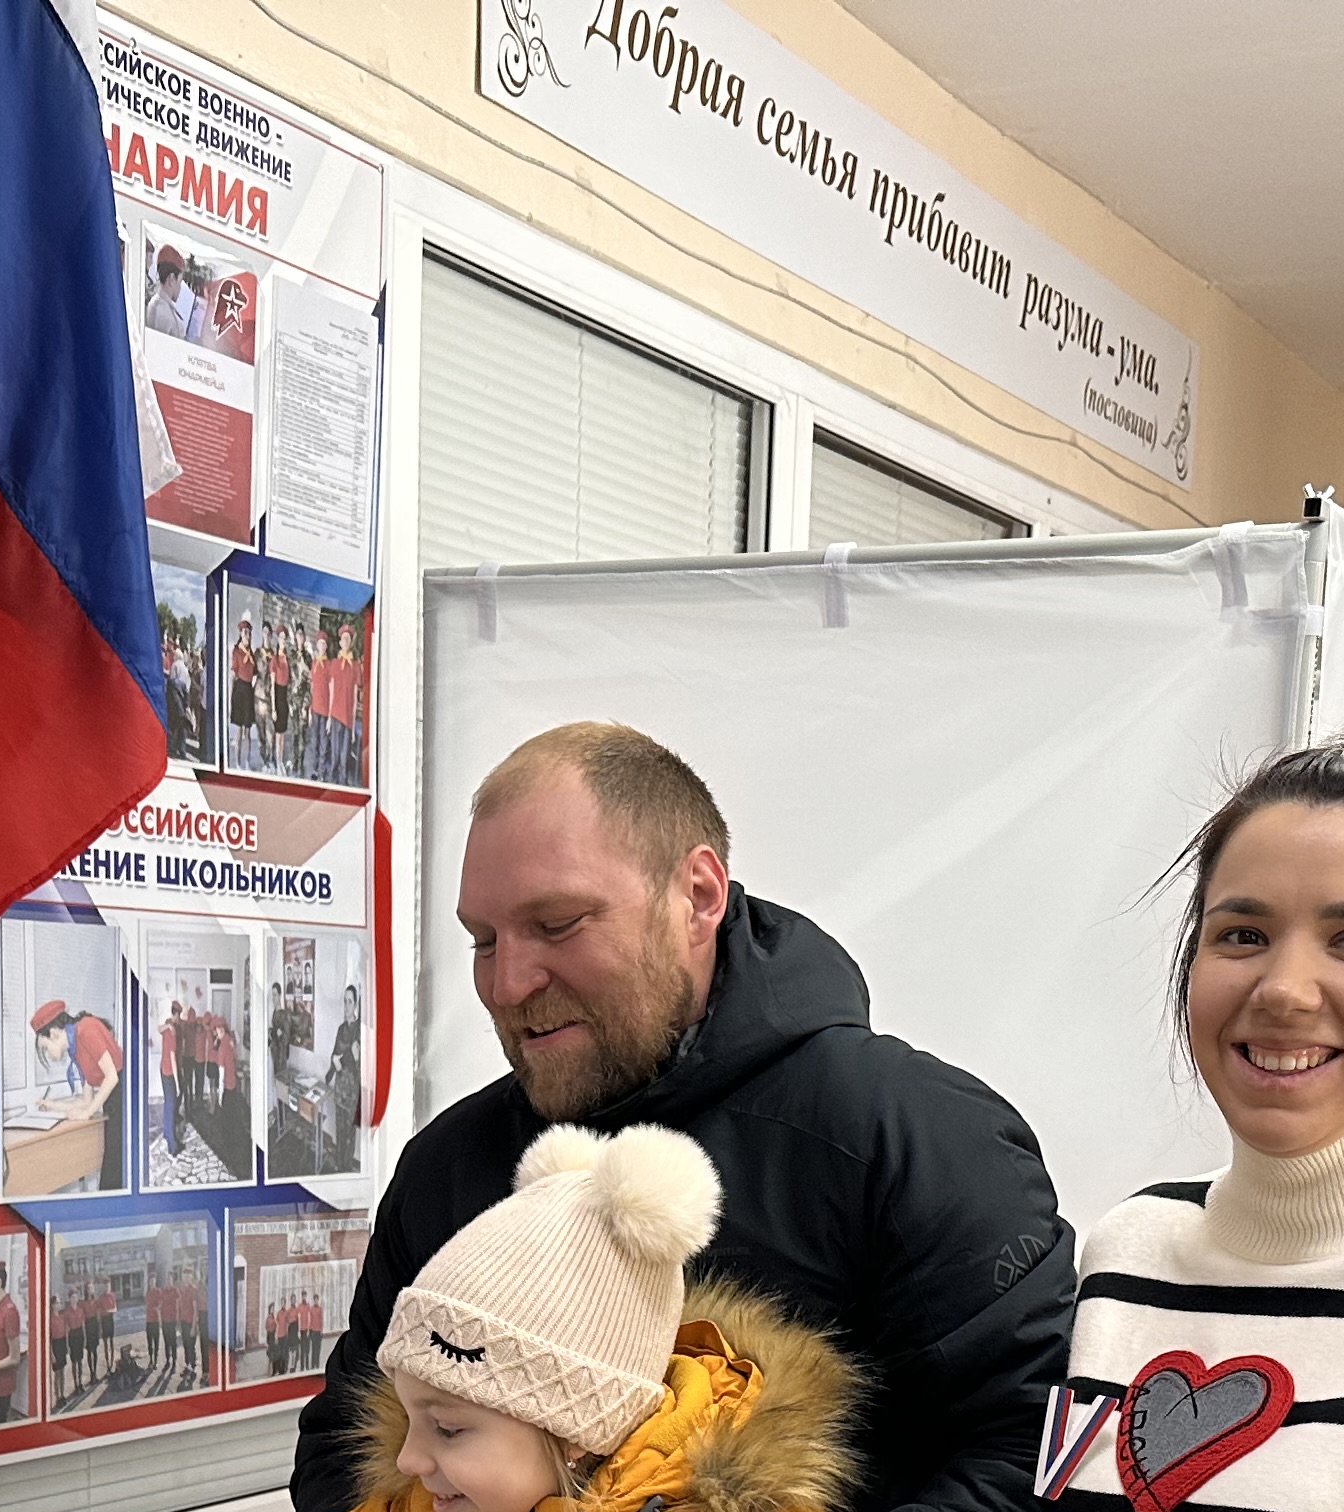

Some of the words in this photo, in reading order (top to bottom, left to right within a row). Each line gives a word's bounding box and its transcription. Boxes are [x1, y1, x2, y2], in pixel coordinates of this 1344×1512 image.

[198, 86, 270, 137] ВОЕННО
[105, 123, 268, 236] НАРМИЯ
[196, 121, 291, 182] ДВИЖЕНИЕ
[584, 0, 744, 128] Добрая
[756, 96, 858, 201] семья
[869, 168, 1012, 299] прибавит
[1082, 378, 1159, 452] (пословица)
[156, 855, 332, 899] ШКОЛЬНИКОВ
